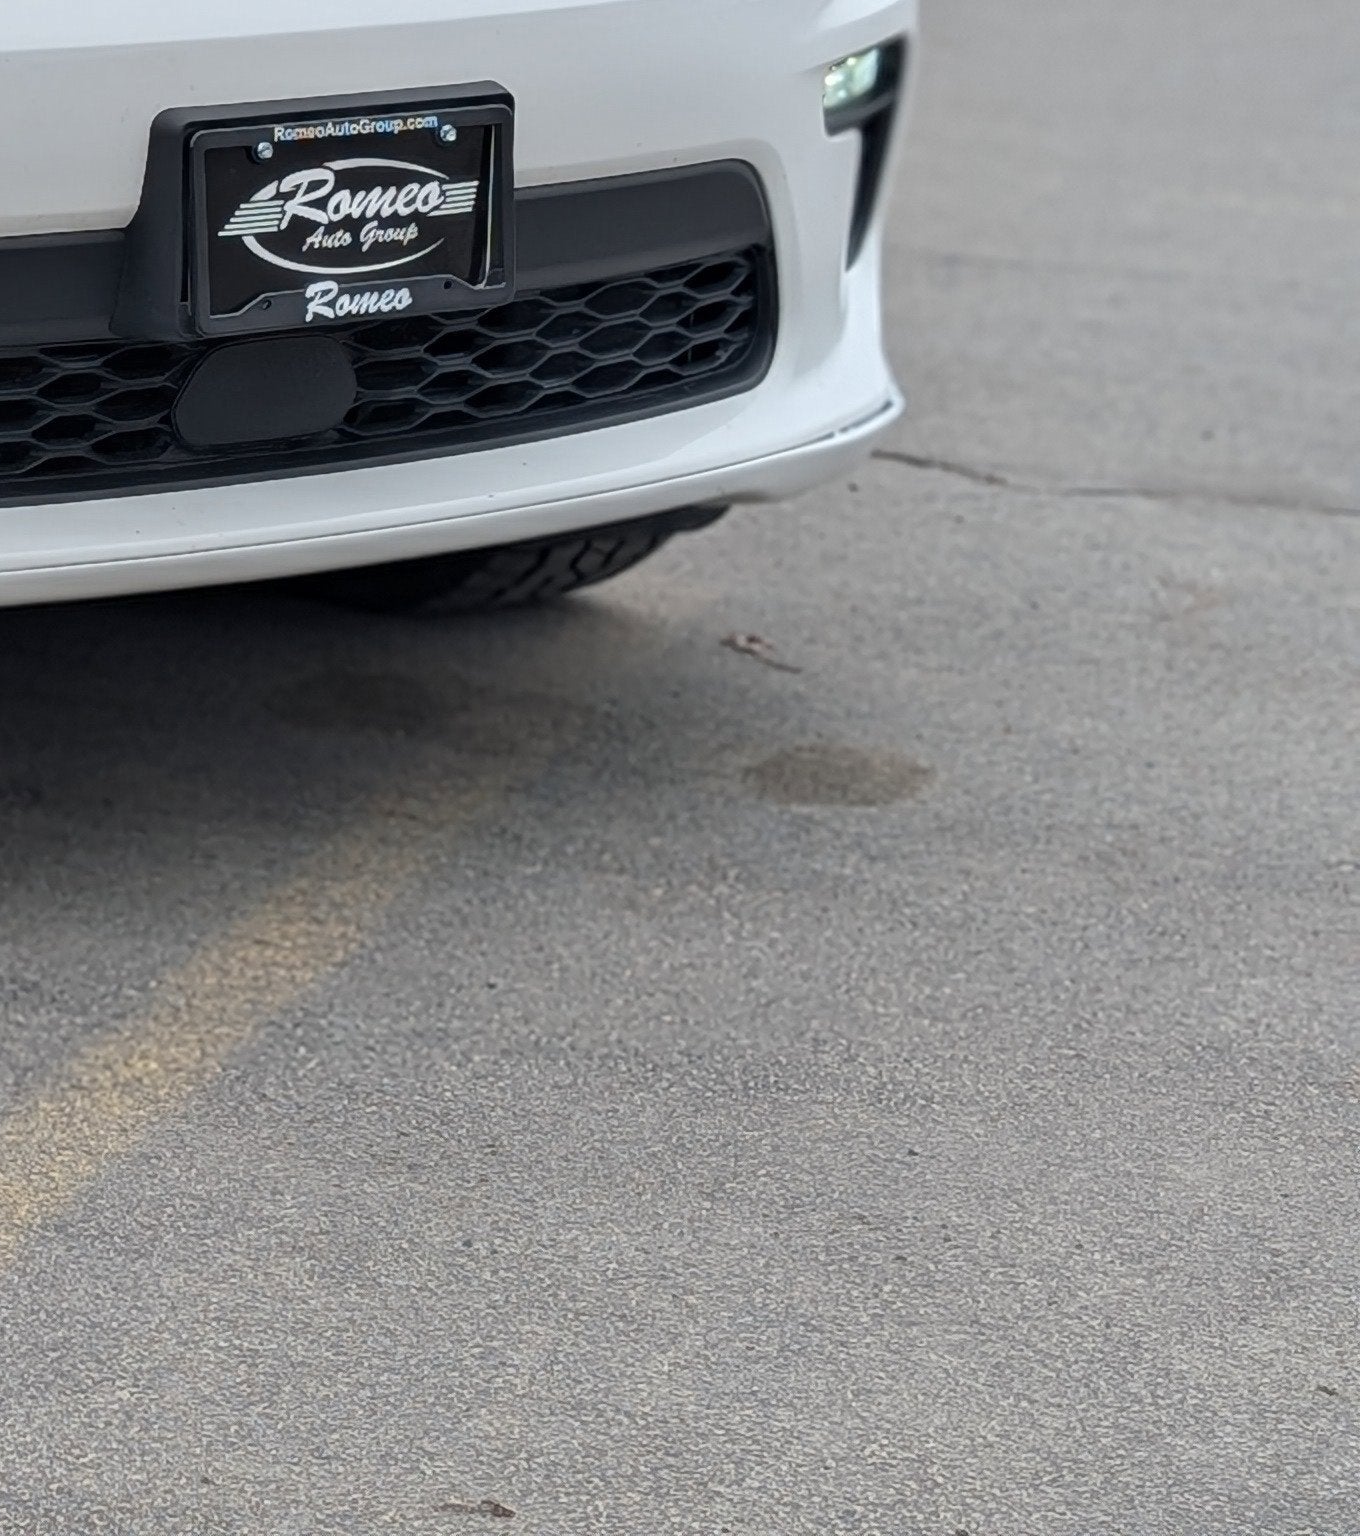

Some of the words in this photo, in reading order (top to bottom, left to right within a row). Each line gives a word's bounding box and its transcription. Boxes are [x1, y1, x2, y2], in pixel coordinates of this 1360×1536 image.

[273, 115, 440, 143] RomeoAutoGroup.com
[279, 168, 446, 231] Romeo
[301, 225, 353, 253] Auto
[359, 220, 419, 253] Group
[304, 280, 413, 323] Romeo
